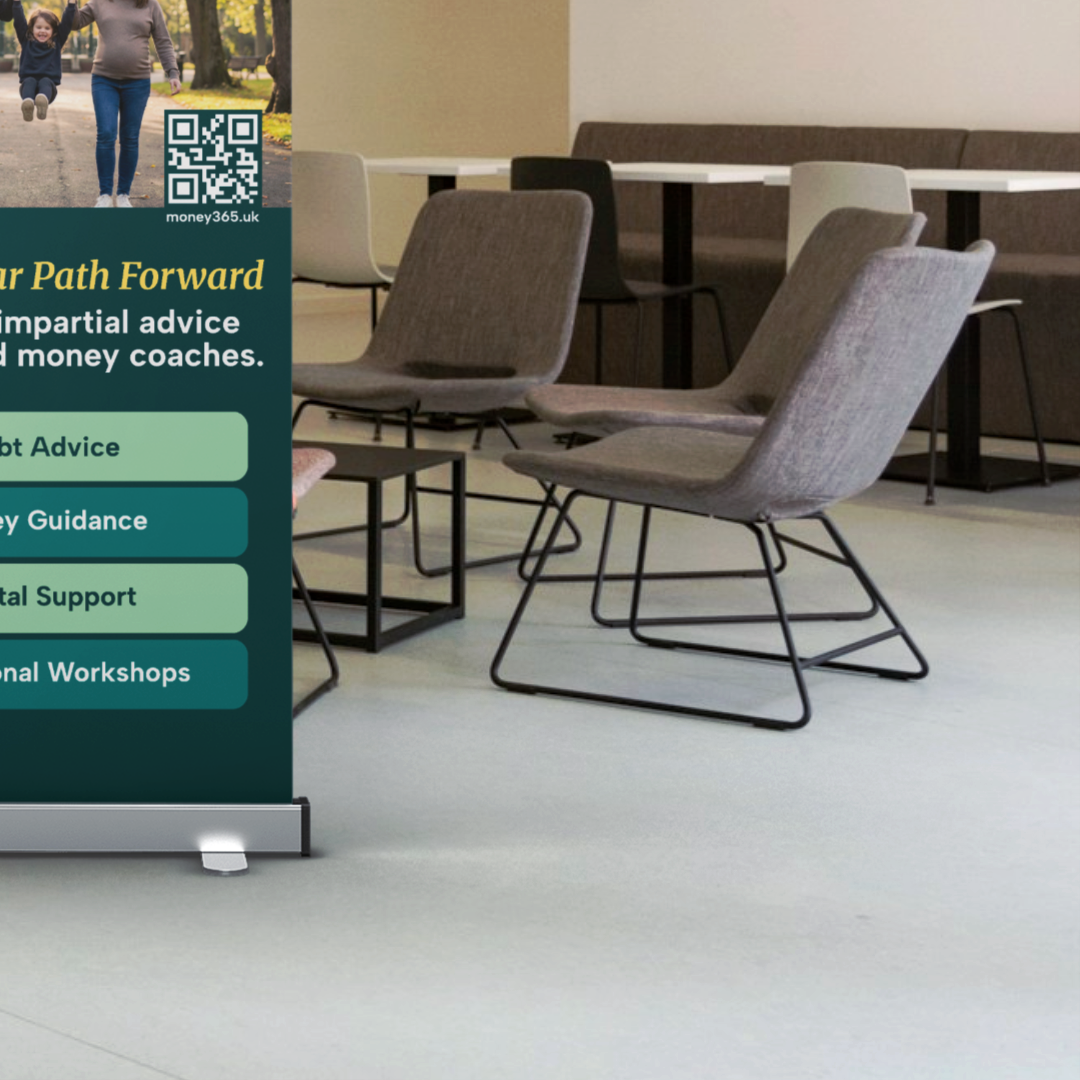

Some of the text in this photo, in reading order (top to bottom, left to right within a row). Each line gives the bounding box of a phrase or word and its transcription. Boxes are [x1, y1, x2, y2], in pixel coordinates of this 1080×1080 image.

[166, 210, 260, 225] money365.uk
[31, 259, 109, 290] Path
[119, 259, 264, 290] Forward
[140, 309, 239, 334] advice
[18, 349, 119, 373] money
[130, 342, 263, 367] coaches.
[30, 436, 120, 457] Advice
[28, 509, 147, 530] Guidance
[37, 586, 136, 611] Support
[48, 661, 190, 687] Workshops
